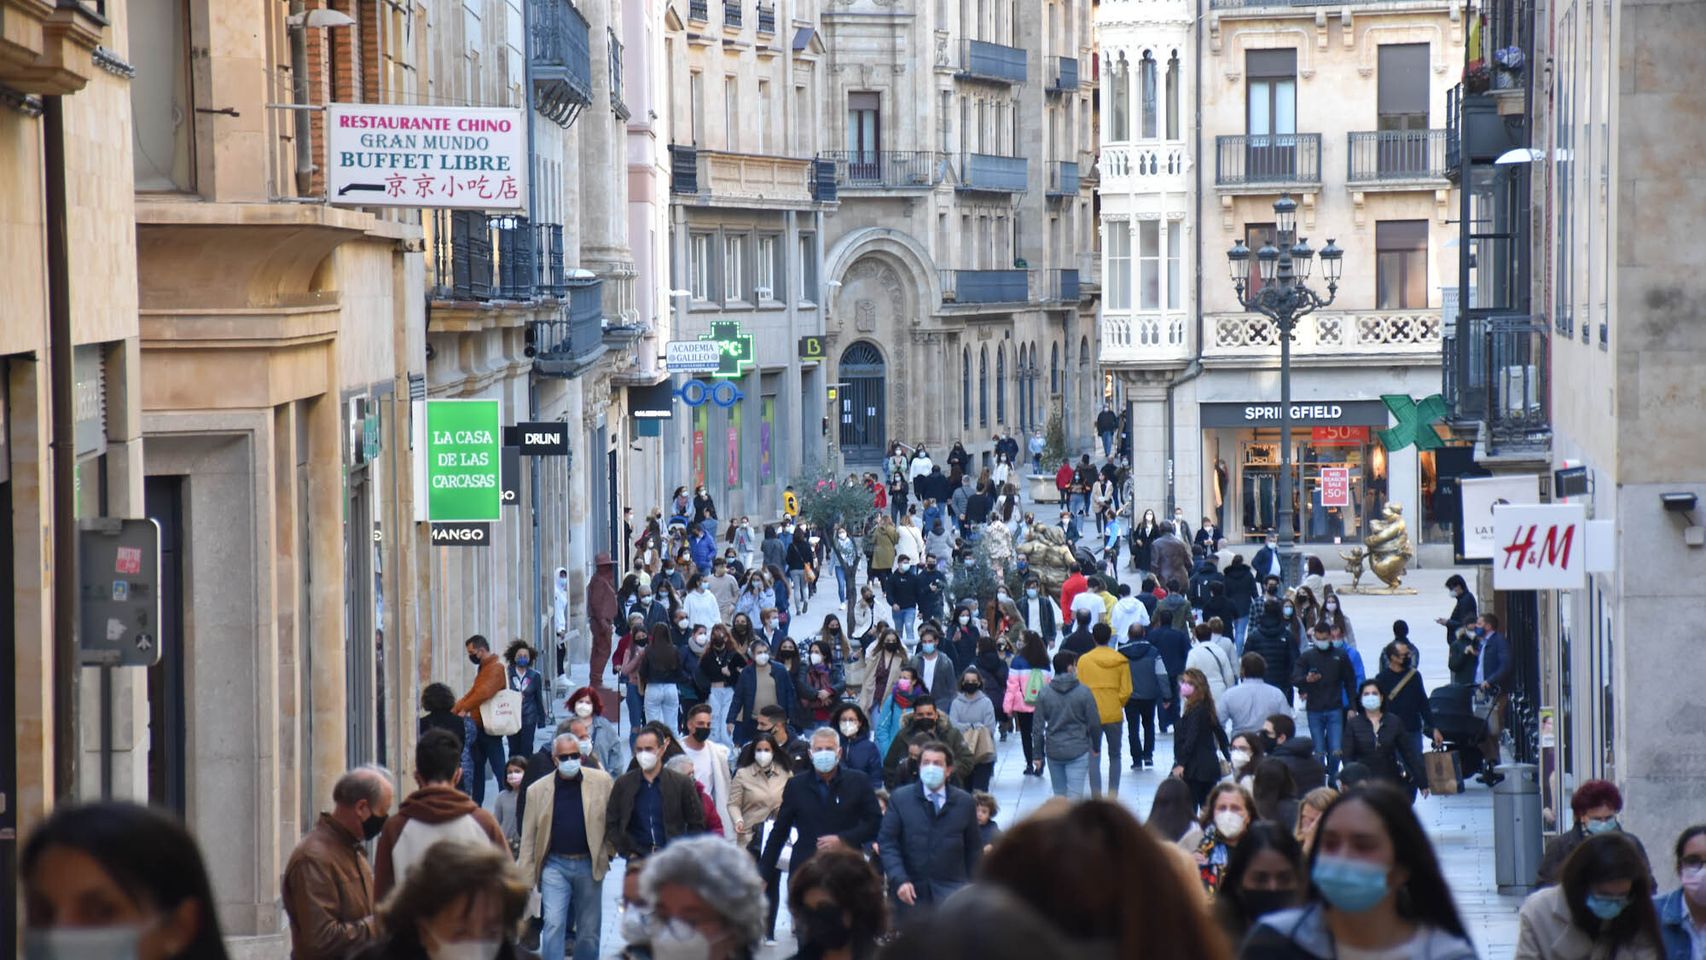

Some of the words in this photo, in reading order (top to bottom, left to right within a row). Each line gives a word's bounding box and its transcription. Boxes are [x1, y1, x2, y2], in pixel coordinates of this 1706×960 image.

[339, 115, 451, 131] RESTAURANTE
[457, 118, 512, 132] CHINO
[360, 133, 417, 149] GRAN
[423, 135, 489, 151] MUNDO
[339, 151, 433, 169] BUFFET
[439, 154, 511, 171] LIBRE
[384, 173, 518, 200] 京京小吃店
[672, 344, 714, 353] ACADEMIA
[676, 353, 710, 362] GALILEO
[433, 431, 453, 445] LA
[455, 430, 493, 444] CASA
[525, 433, 560, 444] DRUNI
[438, 453, 457, 466] DE
[460, 452, 489, 466] LAS
[432, 474, 495, 488] CARCASAS
[1475, 527, 1488, 535] LA
[1503, 524, 1576, 571] H&M
